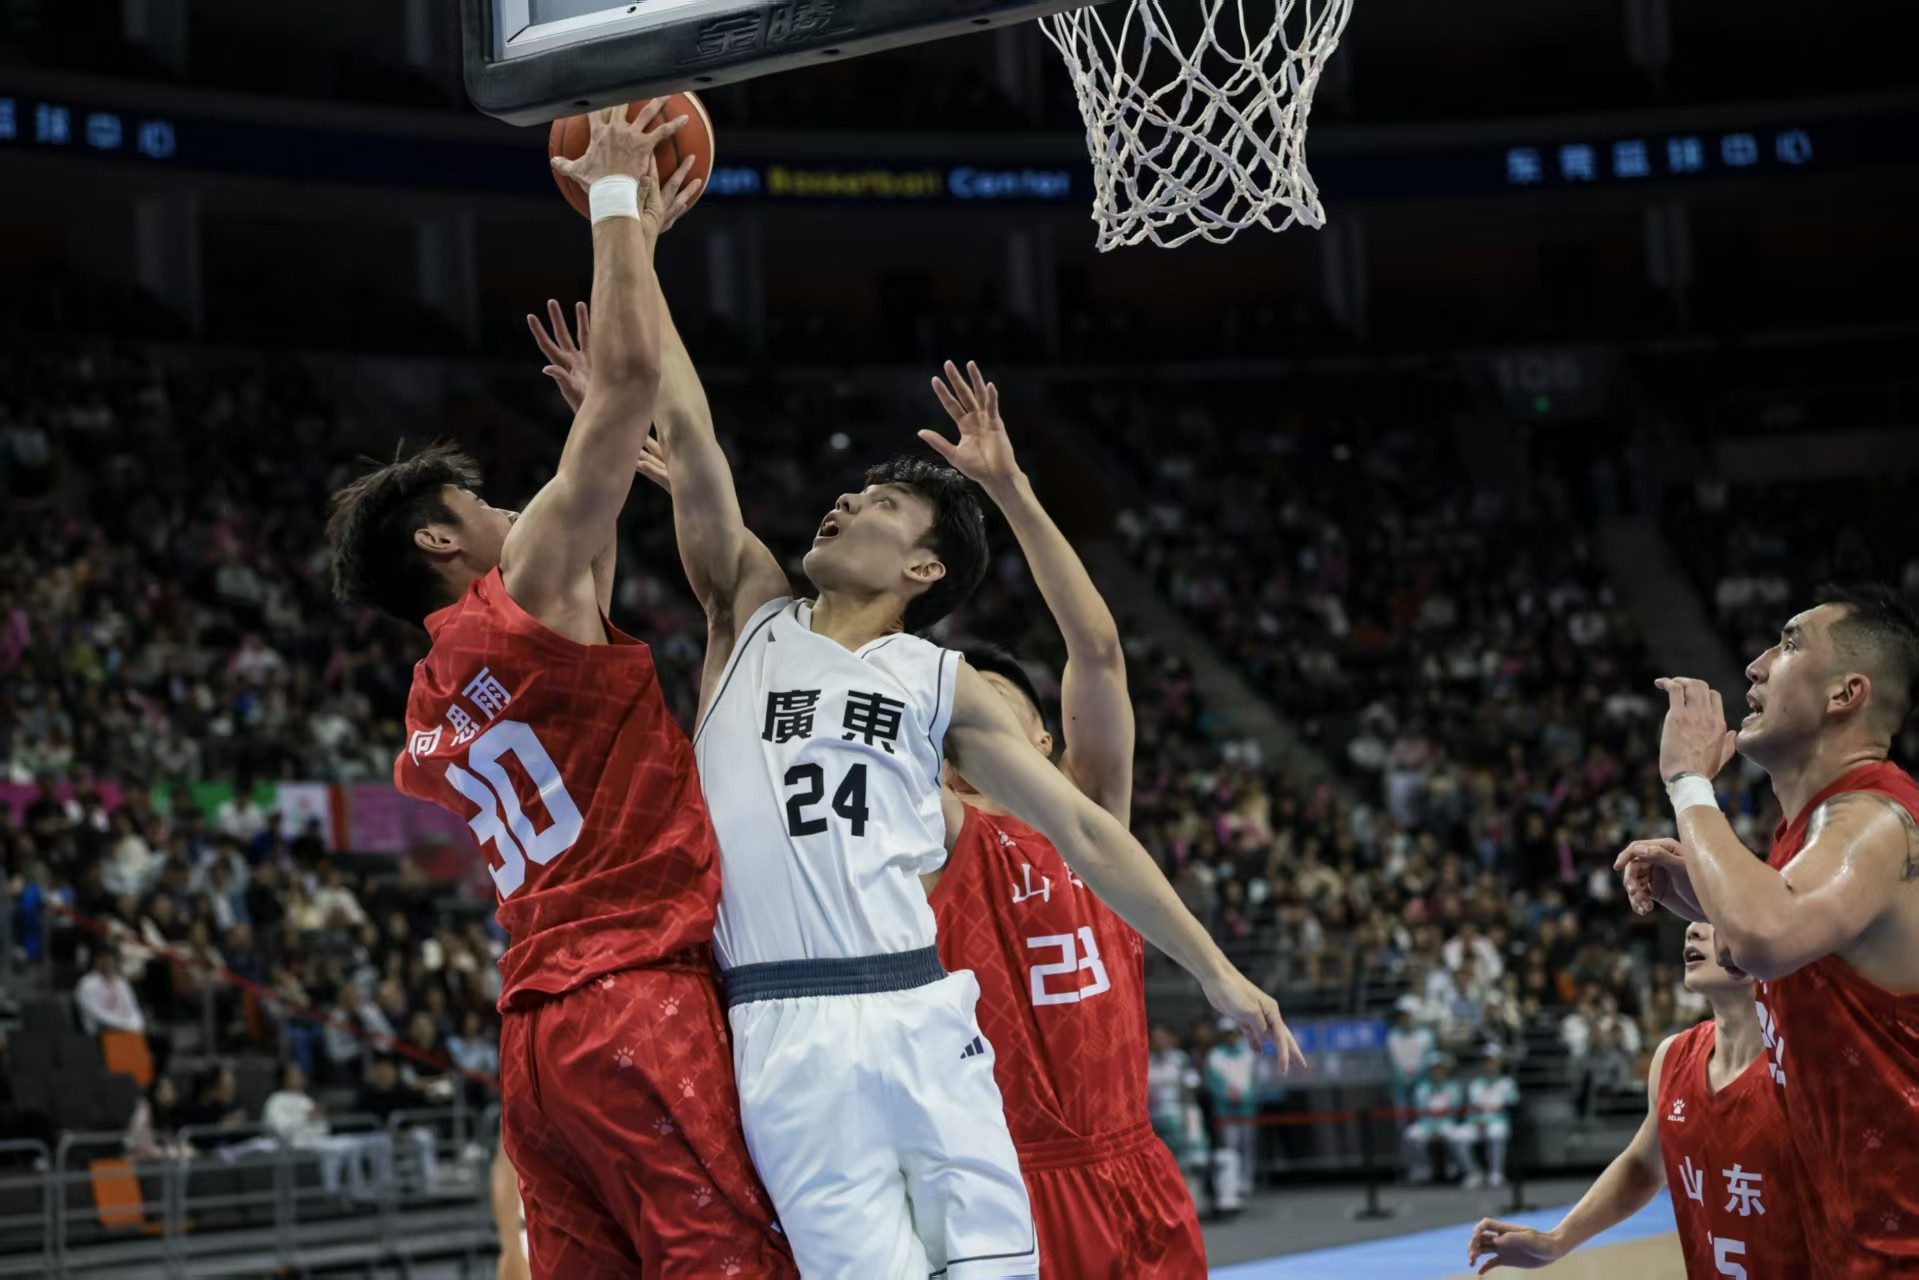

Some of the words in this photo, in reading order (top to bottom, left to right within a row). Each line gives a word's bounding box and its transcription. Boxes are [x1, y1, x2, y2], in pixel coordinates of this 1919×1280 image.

[948, 165, 1071, 198] Center
[761, 688, 906, 754] 廣東
[444, 719, 585, 900] 30
[784, 762, 869, 837] 24
[1026, 925, 1111, 1006] 23
[1678, 1155, 1766, 1217] 山东
